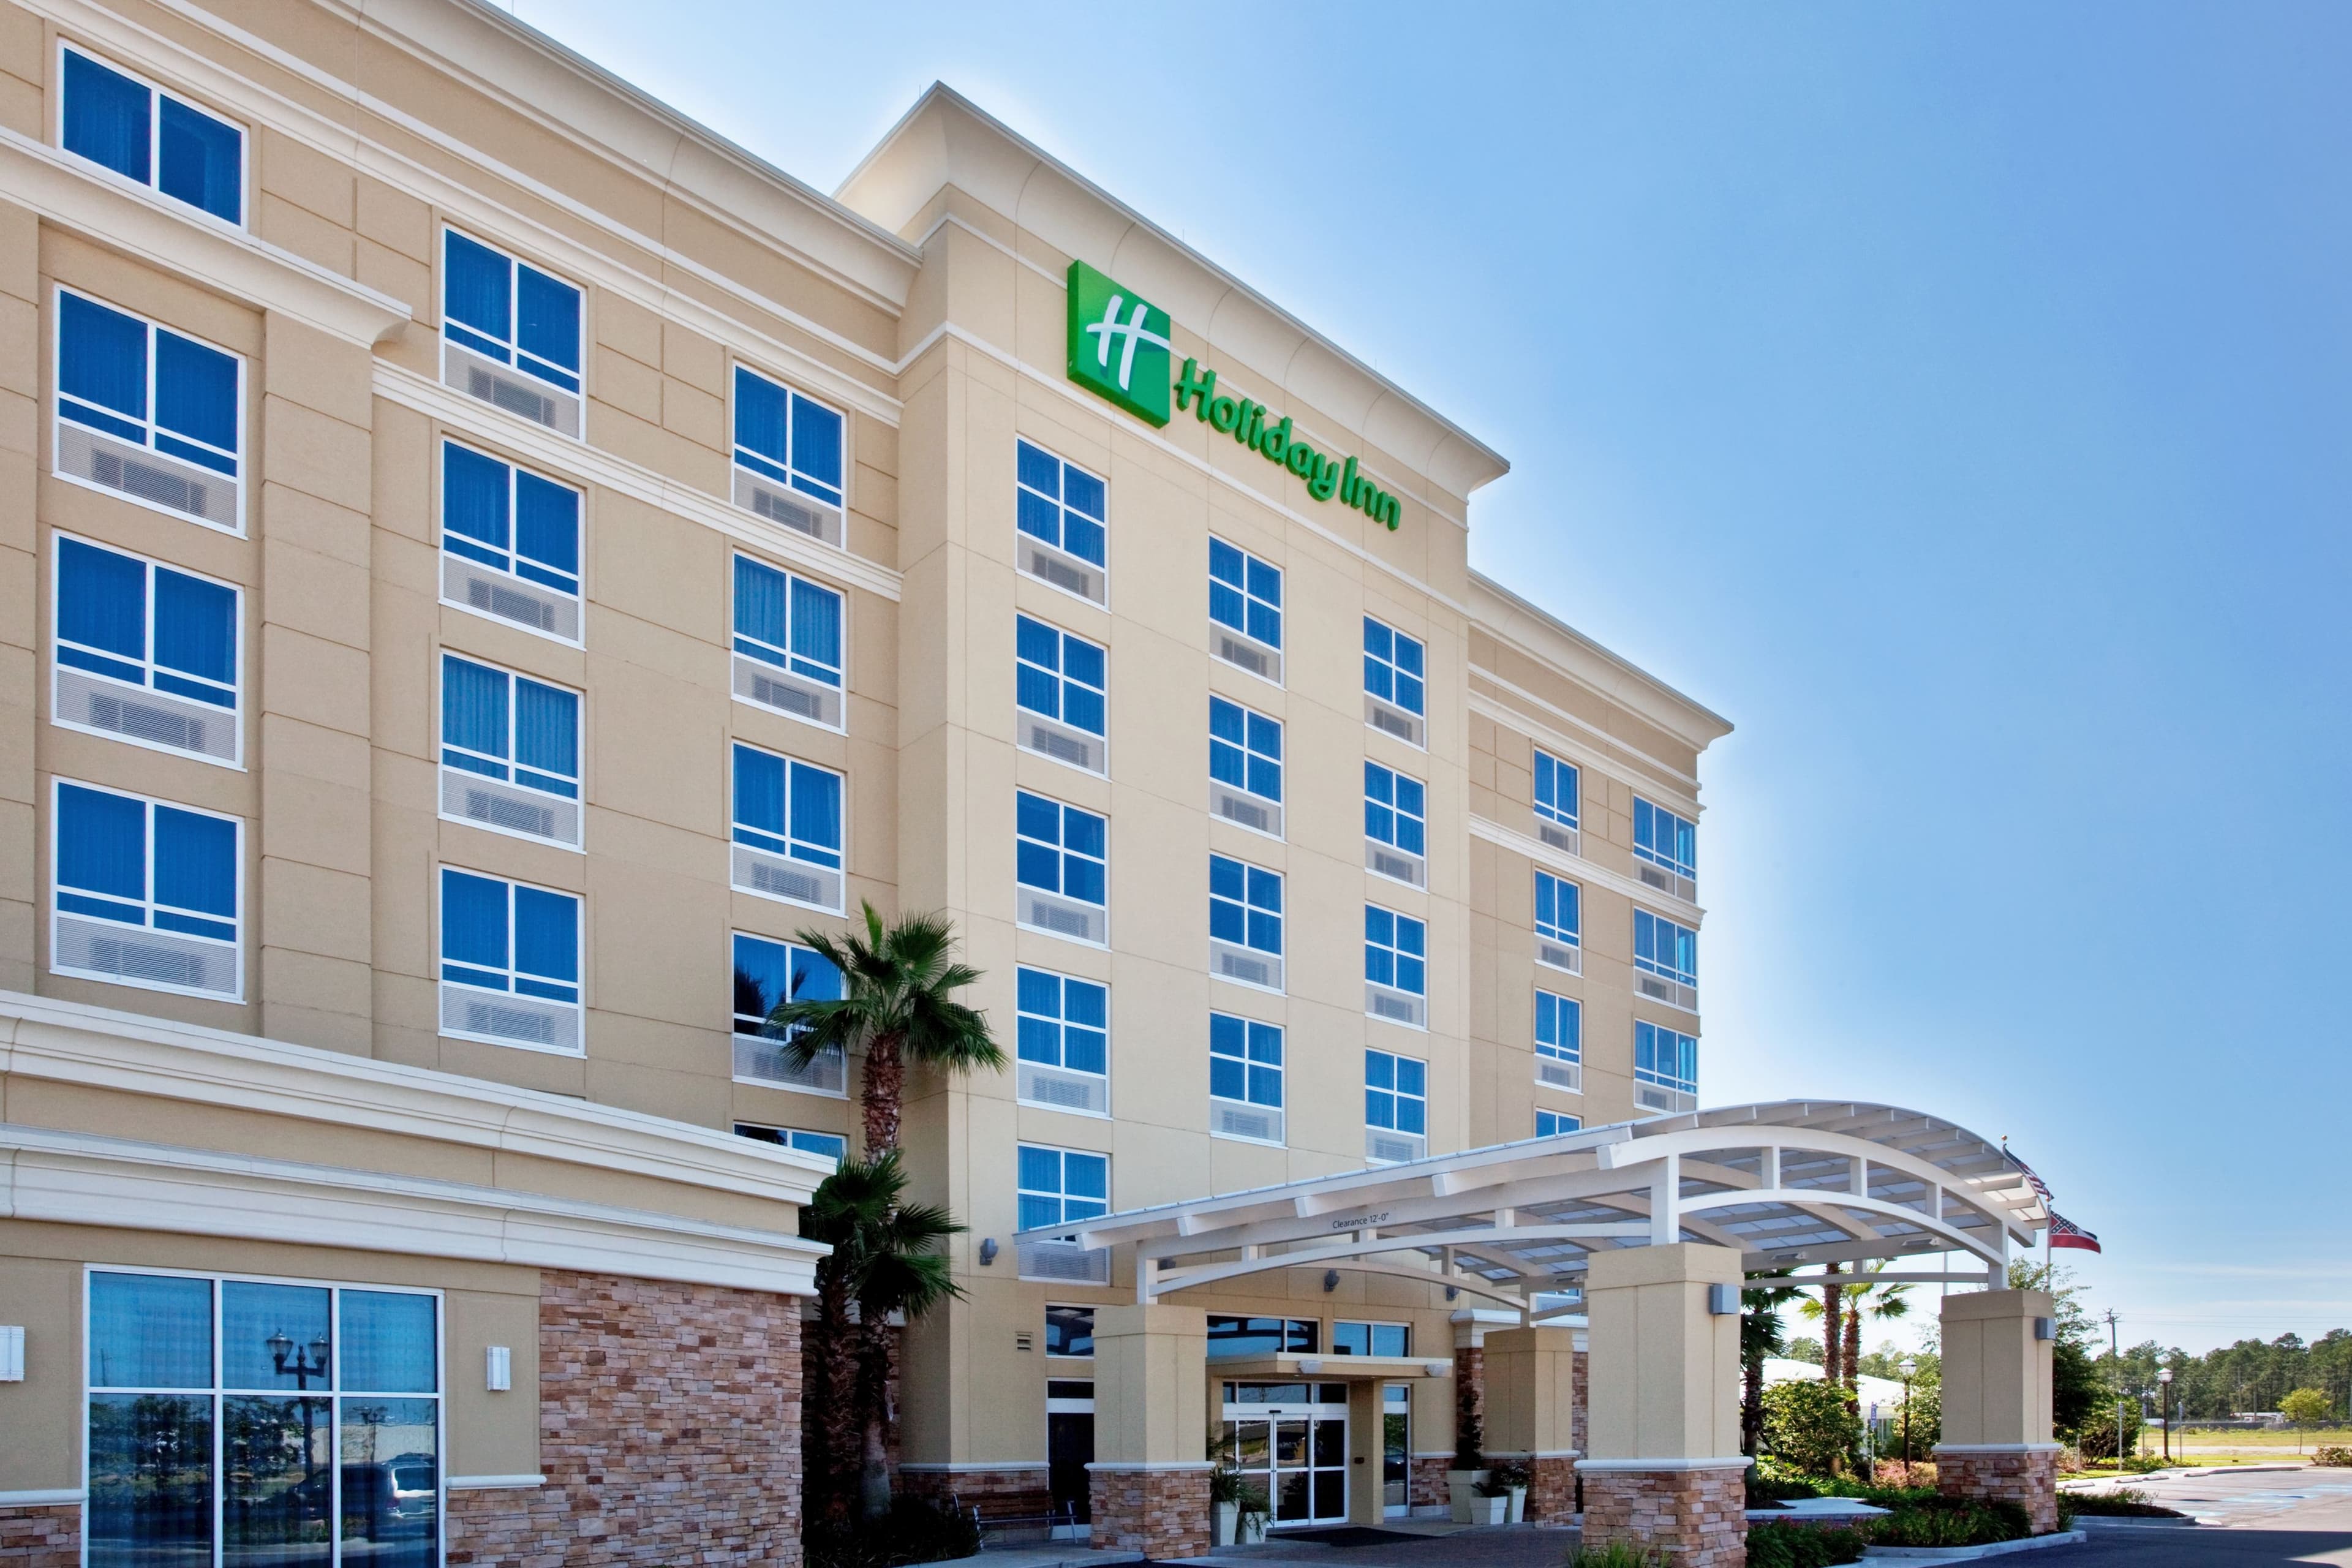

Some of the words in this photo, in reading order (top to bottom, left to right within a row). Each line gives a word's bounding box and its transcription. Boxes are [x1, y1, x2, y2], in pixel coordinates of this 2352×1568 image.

[1174, 357, 1340, 502] Holiday
[1340, 456, 1401, 531] Inn
[1332, 1218, 1368, 1229] Clearance
